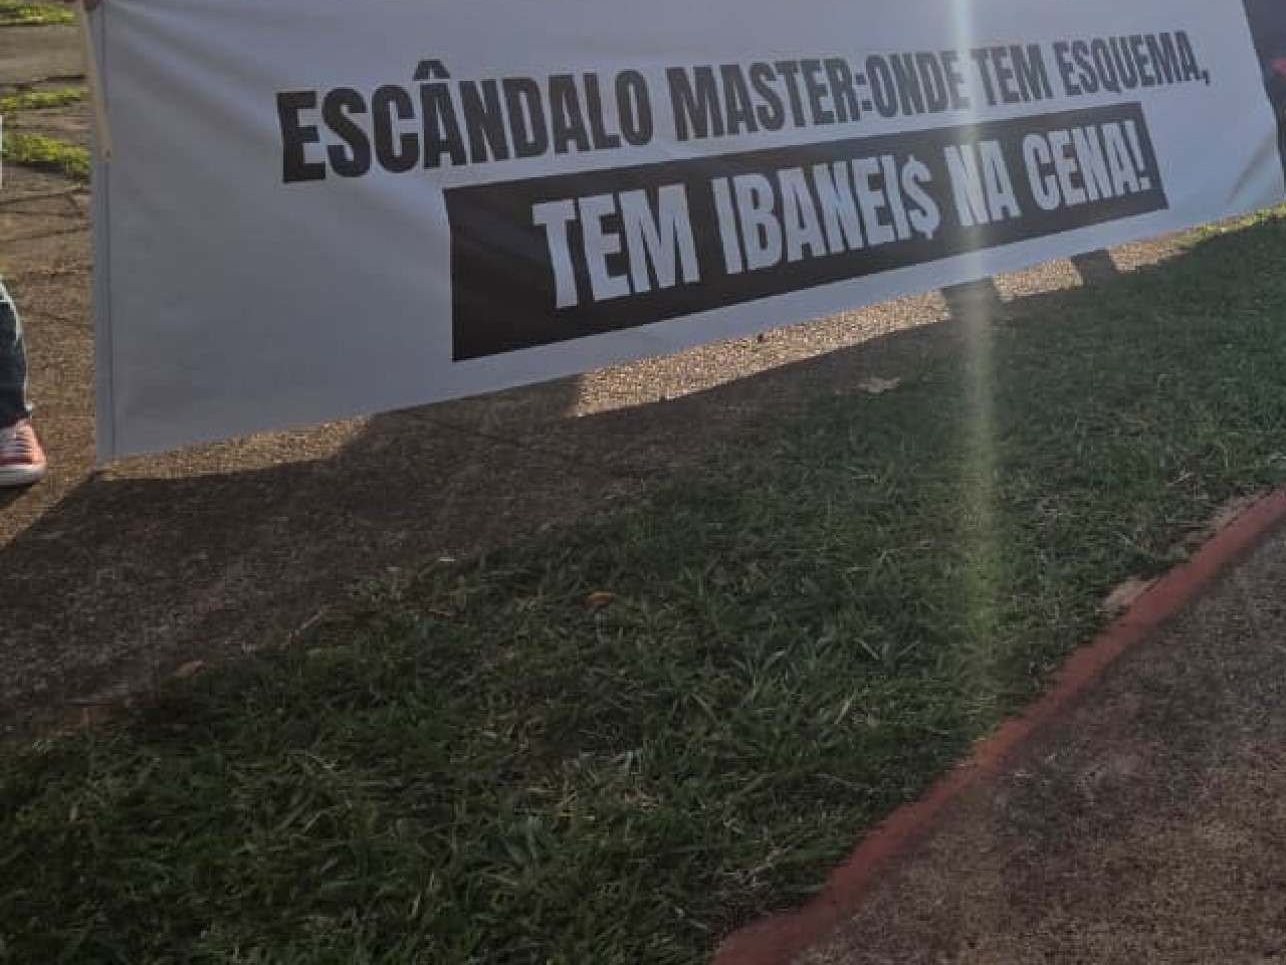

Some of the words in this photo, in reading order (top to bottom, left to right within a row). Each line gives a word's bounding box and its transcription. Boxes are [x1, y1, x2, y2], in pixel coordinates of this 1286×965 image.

[276, 59, 654, 184] ESCÂNDALO
[971, 43, 1054, 106] TEM
[1052, 30, 1211, 97] ESQUEMA,
[532, 184, 701, 310] TEM
[712, 154, 941, 275] IBANEI$
[944, 140, 1021, 227] NA
[1022, 119, 1151, 211] CENA!
